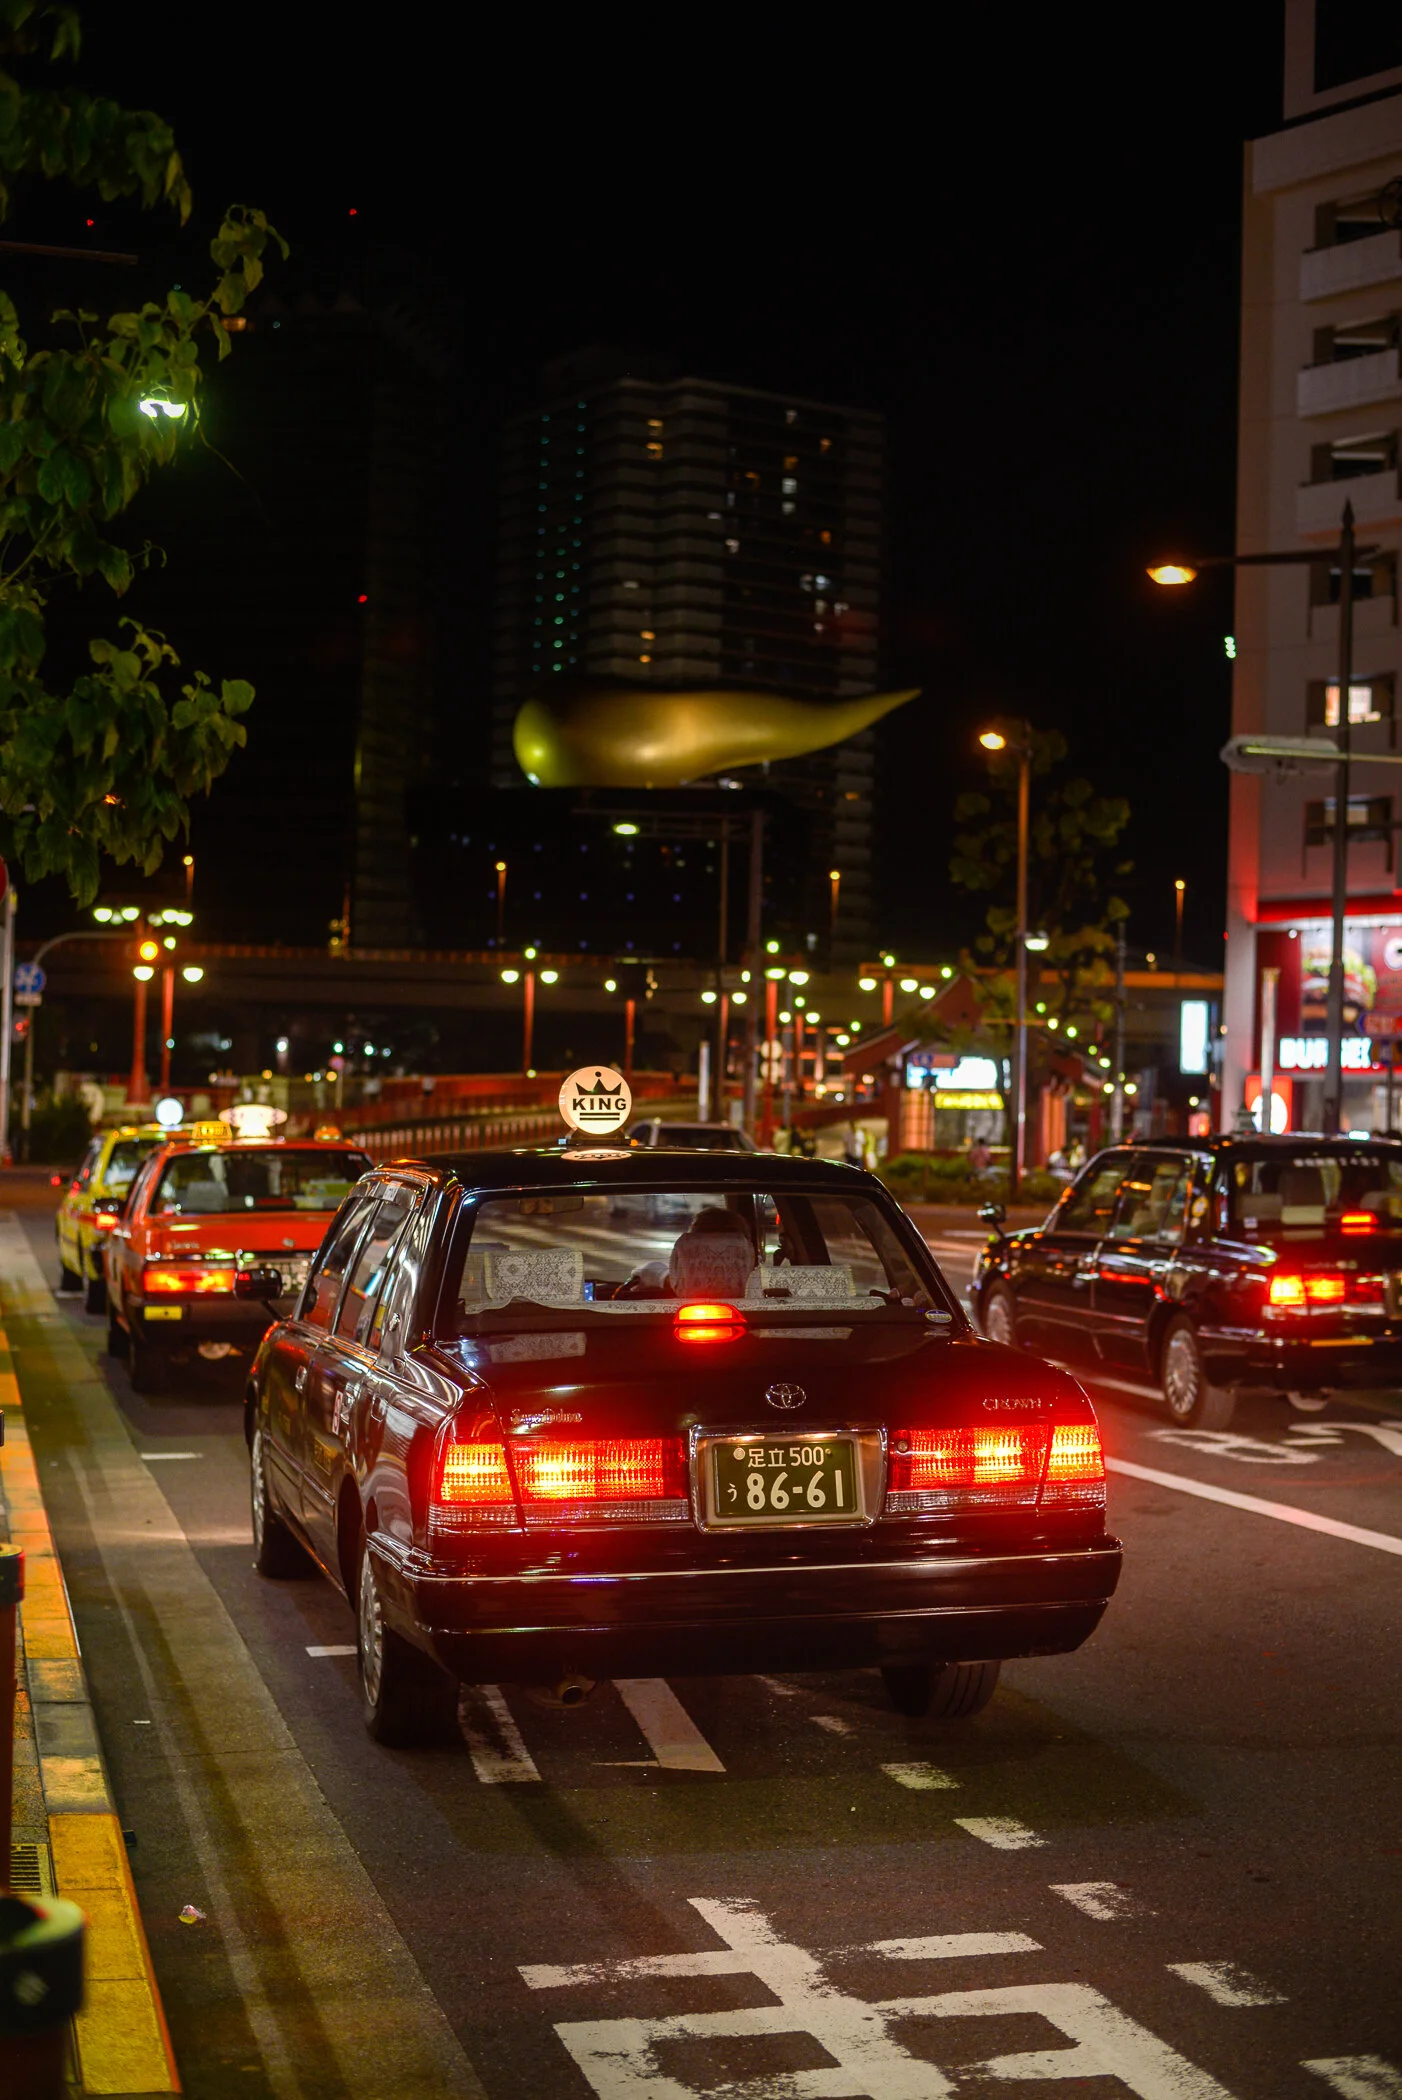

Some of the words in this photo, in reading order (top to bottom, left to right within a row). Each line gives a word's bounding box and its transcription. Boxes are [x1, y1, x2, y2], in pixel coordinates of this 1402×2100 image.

[572, 1098, 627, 1111] KING
[982, 1398, 1041, 1411] CROWN
[748, 1448, 786, 1467] 足立
[789, 1446, 824, 1466] 500
[727, 1483, 738, 1502] う
[746, 1470, 844, 1510] 86-61
